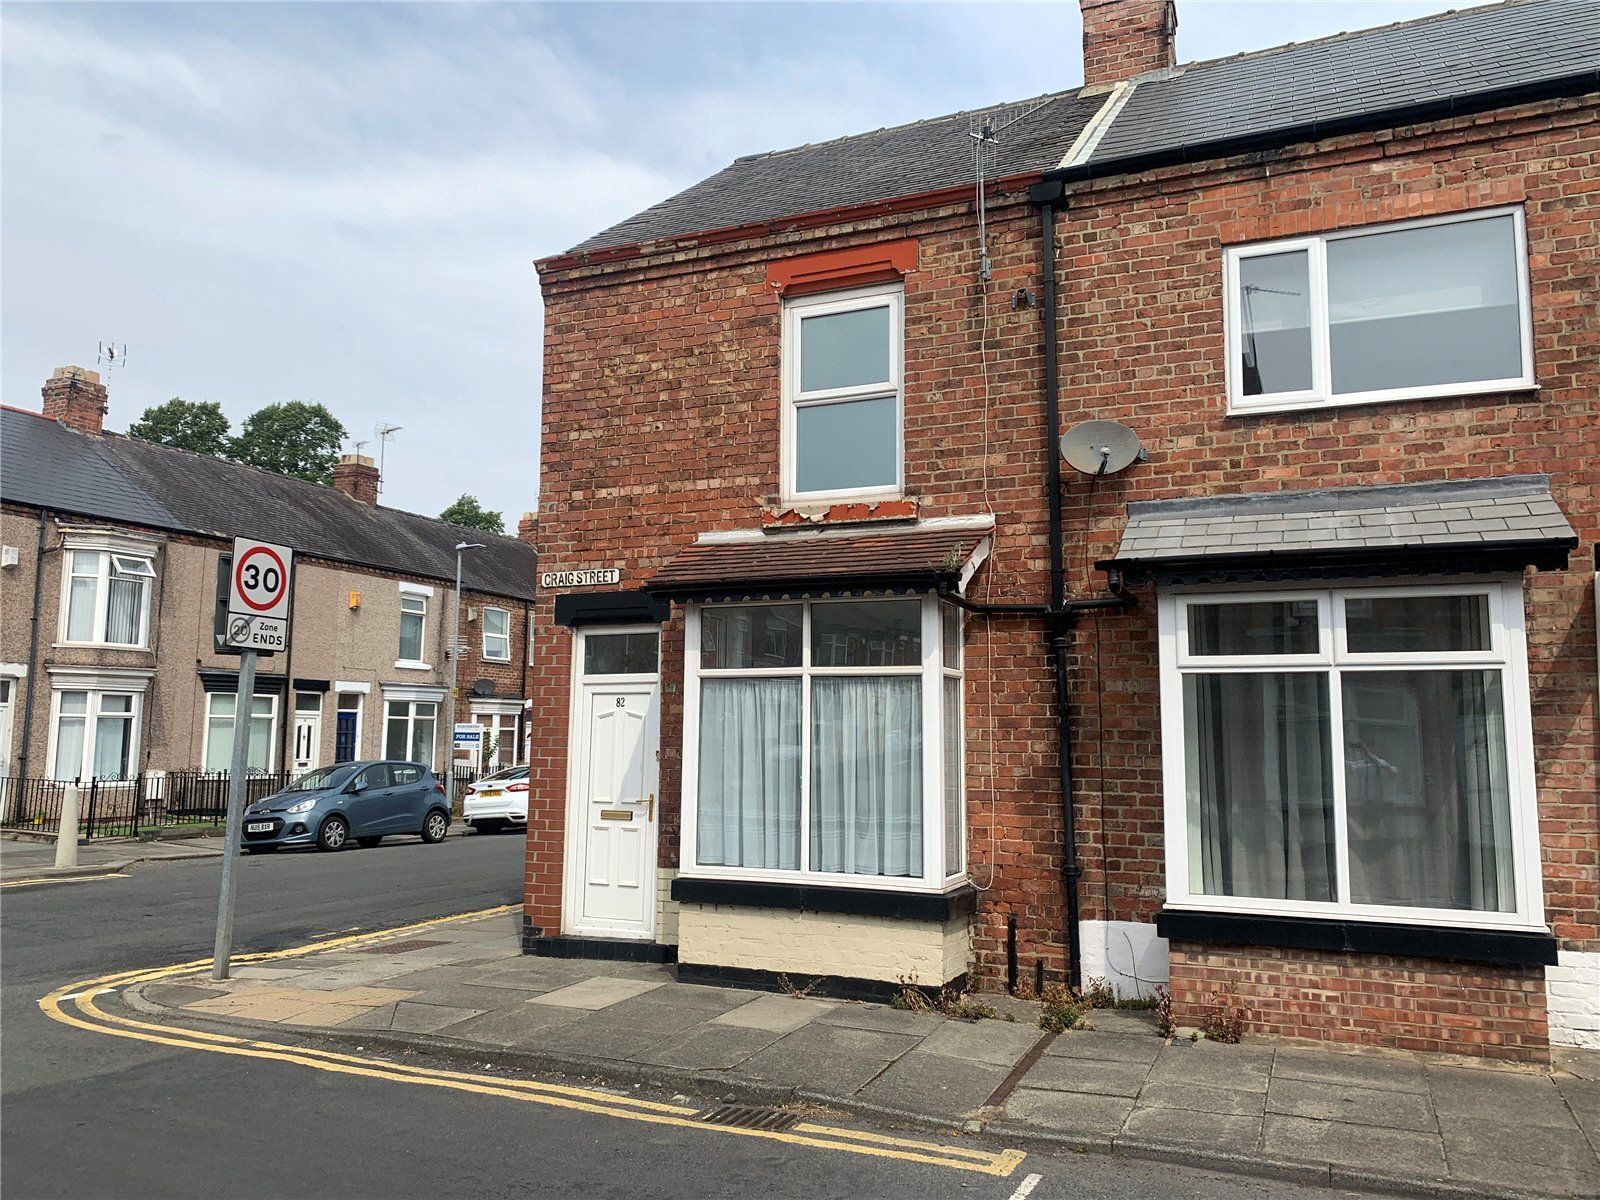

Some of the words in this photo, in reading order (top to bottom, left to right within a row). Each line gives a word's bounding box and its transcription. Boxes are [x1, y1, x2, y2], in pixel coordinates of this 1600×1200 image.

[244, 564, 279, 593] 30
[544, 572, 574, 586] CRAIG
[576, 570, 616, 584] STREET
[233, 624, 248, 636] 20
[259, 622, 278, 632] Zone
[253, 633, 282, 645] ENDS
[616, 697, 625, 707] 82
